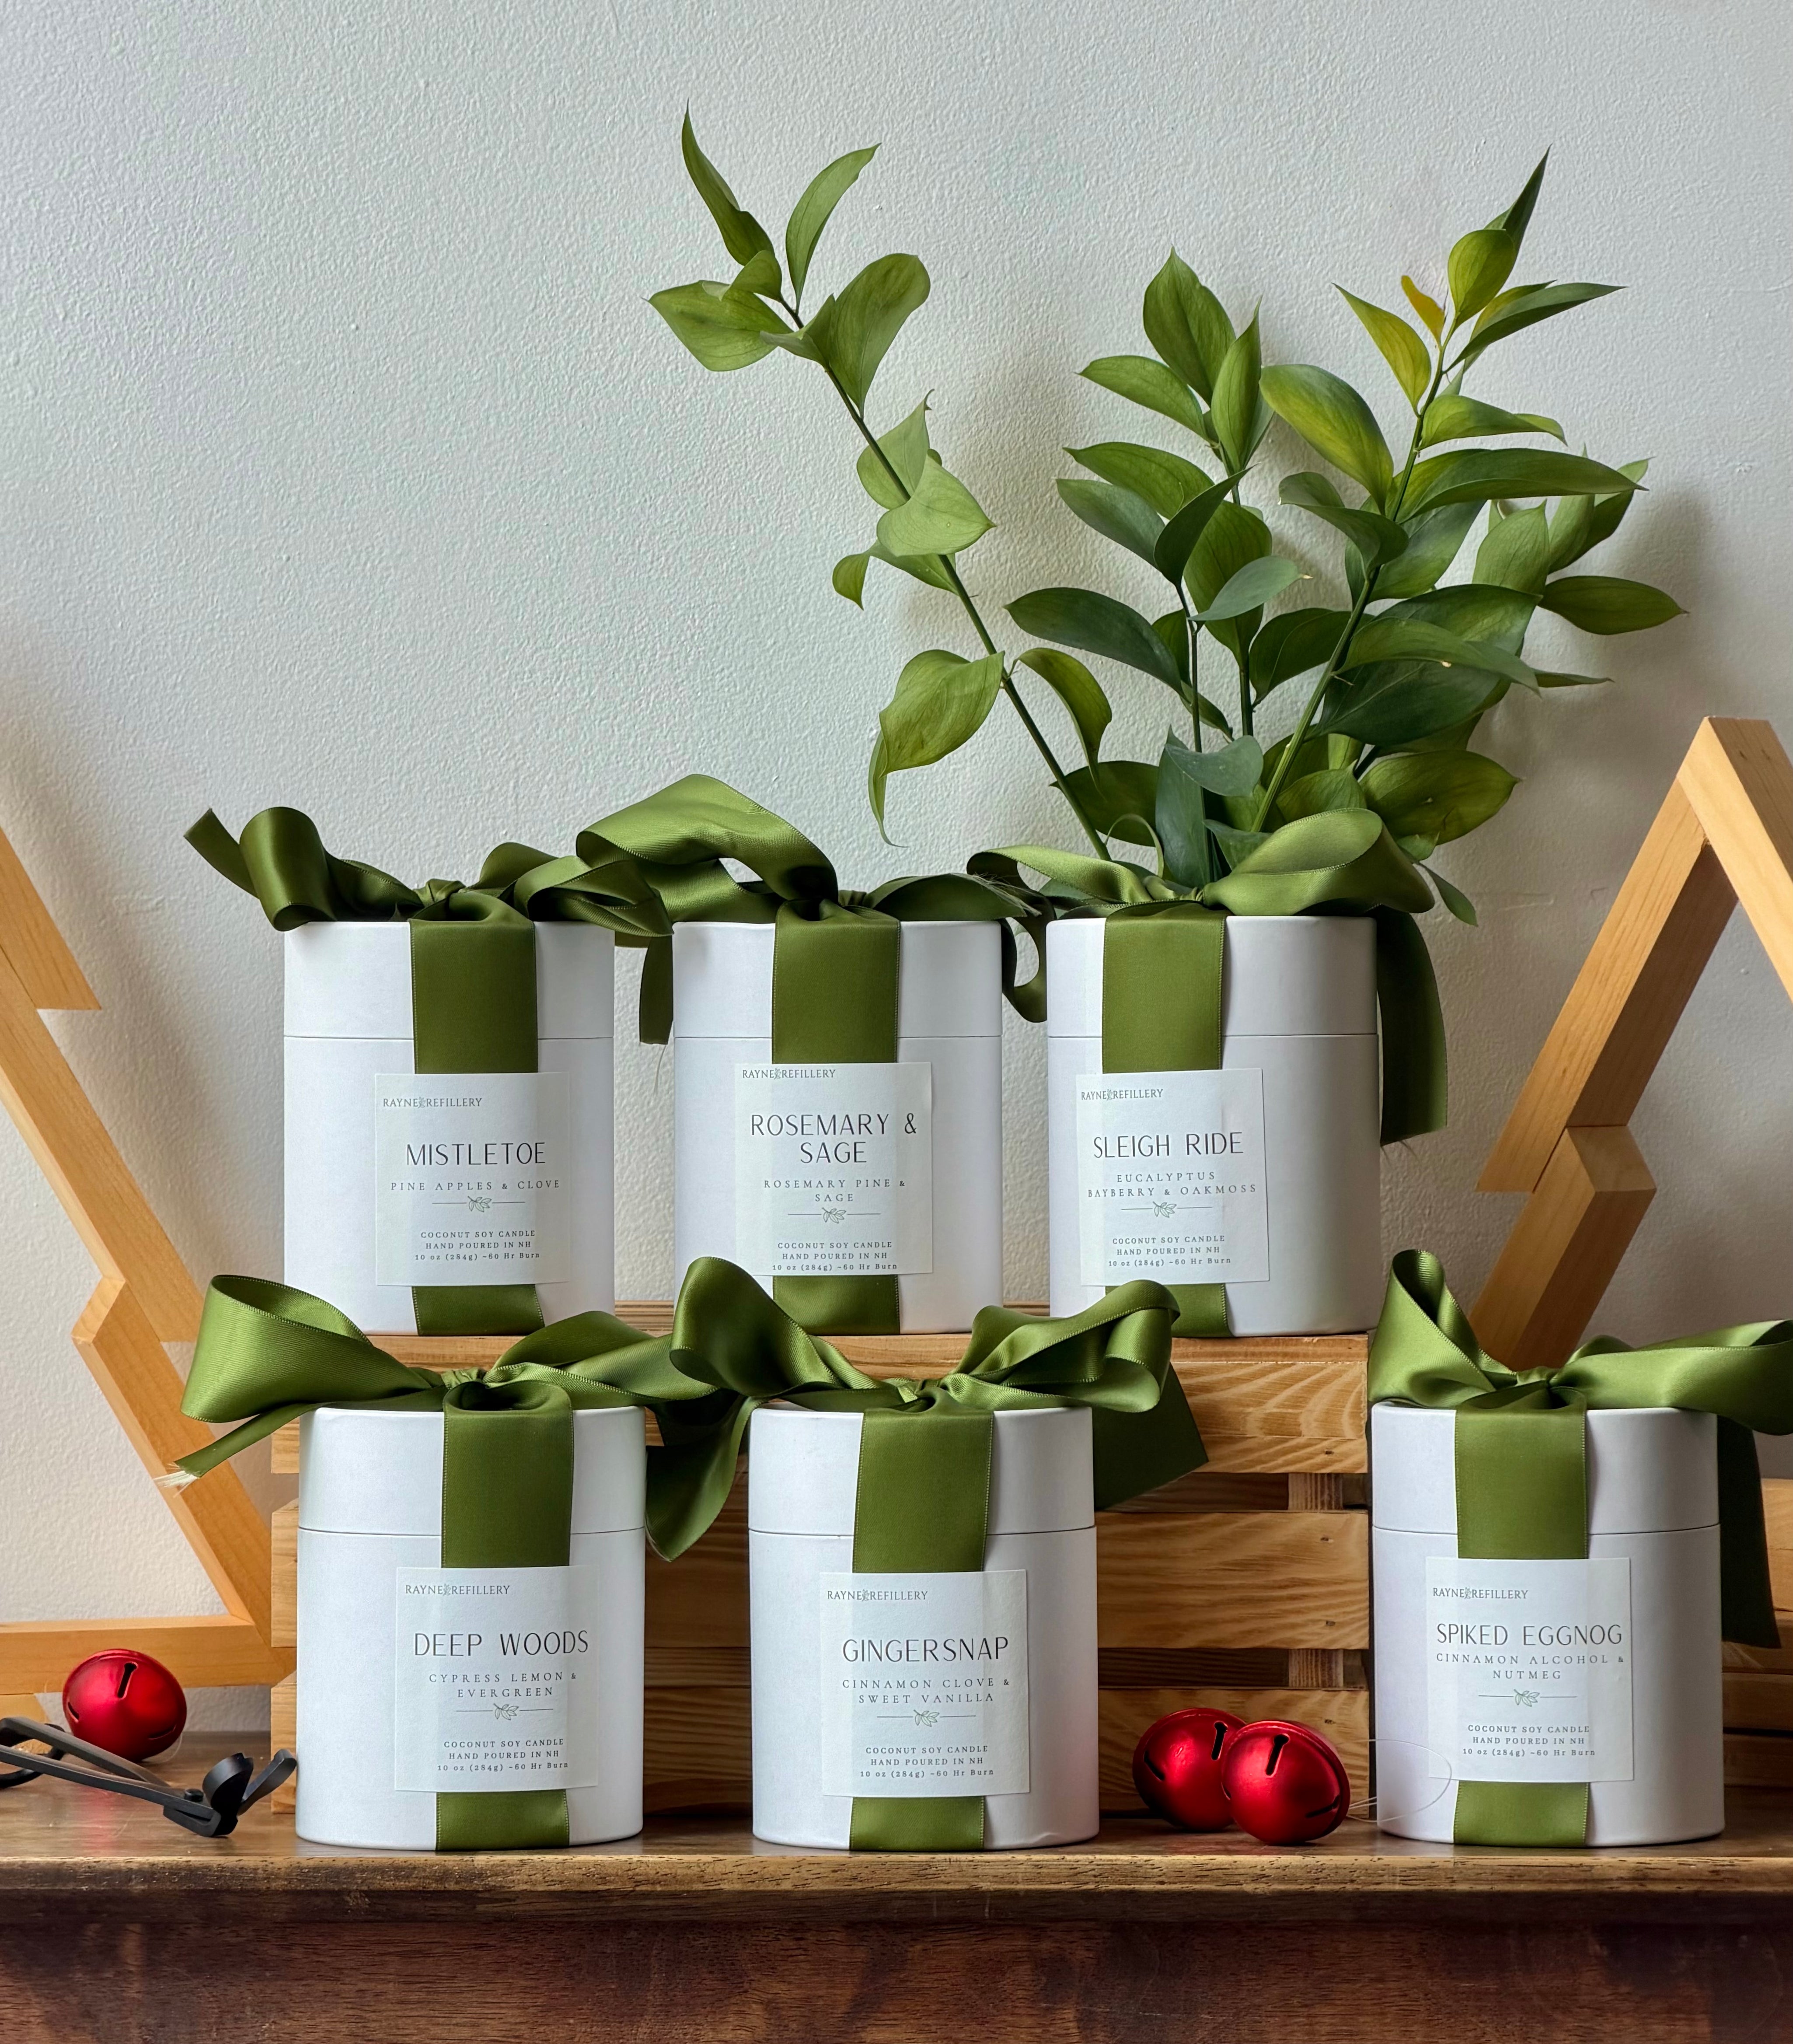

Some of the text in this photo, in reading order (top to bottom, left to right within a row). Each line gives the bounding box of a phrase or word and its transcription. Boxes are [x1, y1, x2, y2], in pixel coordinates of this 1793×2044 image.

[743, 1069, 836, 1078] RAYNE REFILLERY
[1081, 1089, 1163, 1100] RAYNE REFILLERY
[383, 1098, 482, 1107] RAYNE REFILLERY
[752, 1113, 917, 1136] ROSEMARY &
[1094, 1132, 1243, 1158] SLEIGH RIDE
[407, 1142, 545, 1165] MISTLETOE
[800, 1142, 867, 1164] SAGE
[1117, 1172, 1215, 1182] EUCALYPTUS
[436, 1182, 492, 1190] APPLES
[518, 1180, 560, 1189] CLOVE
[1088, 1188, 1155, 1197] BAYBERRY
[1180, 1184, 1256, 1195] OAKMOSS
[406, 1585, 510, 1595] RAYNE REFILLERY
[827, 1591, 928, 1600] RAYNE REFILLERY
[1433, 1588, 1528, 1599] RAYNE REFILLERY
[1437, 1623, 1622, 1646] SPIKED EGGNOG
[415, 1630, 588, 1656] DEEP WOODS
[843, 1637, 1008, 1662] GINGERSNAP
[1437, 1653, 1518, 1664] CINNAMON
[1530, 1655, 1608, 1664] ALCOHOL
[429, 1674, 500, 1683] CYPRESS
[512, 1672, 563, 1682] LEMON
[1493, 1670, 1561, 1679] NUTMEG
[843, 1680, 931, 1688] CINNAMON
[943, 1678, 994, 1688] CLOVE
[458, 1688, 553, 1698] EVERGREEN
[859, 1693, 993, 1703] SWEET VANILLA
[1492, 1749, 1525, 1757] (284g)
